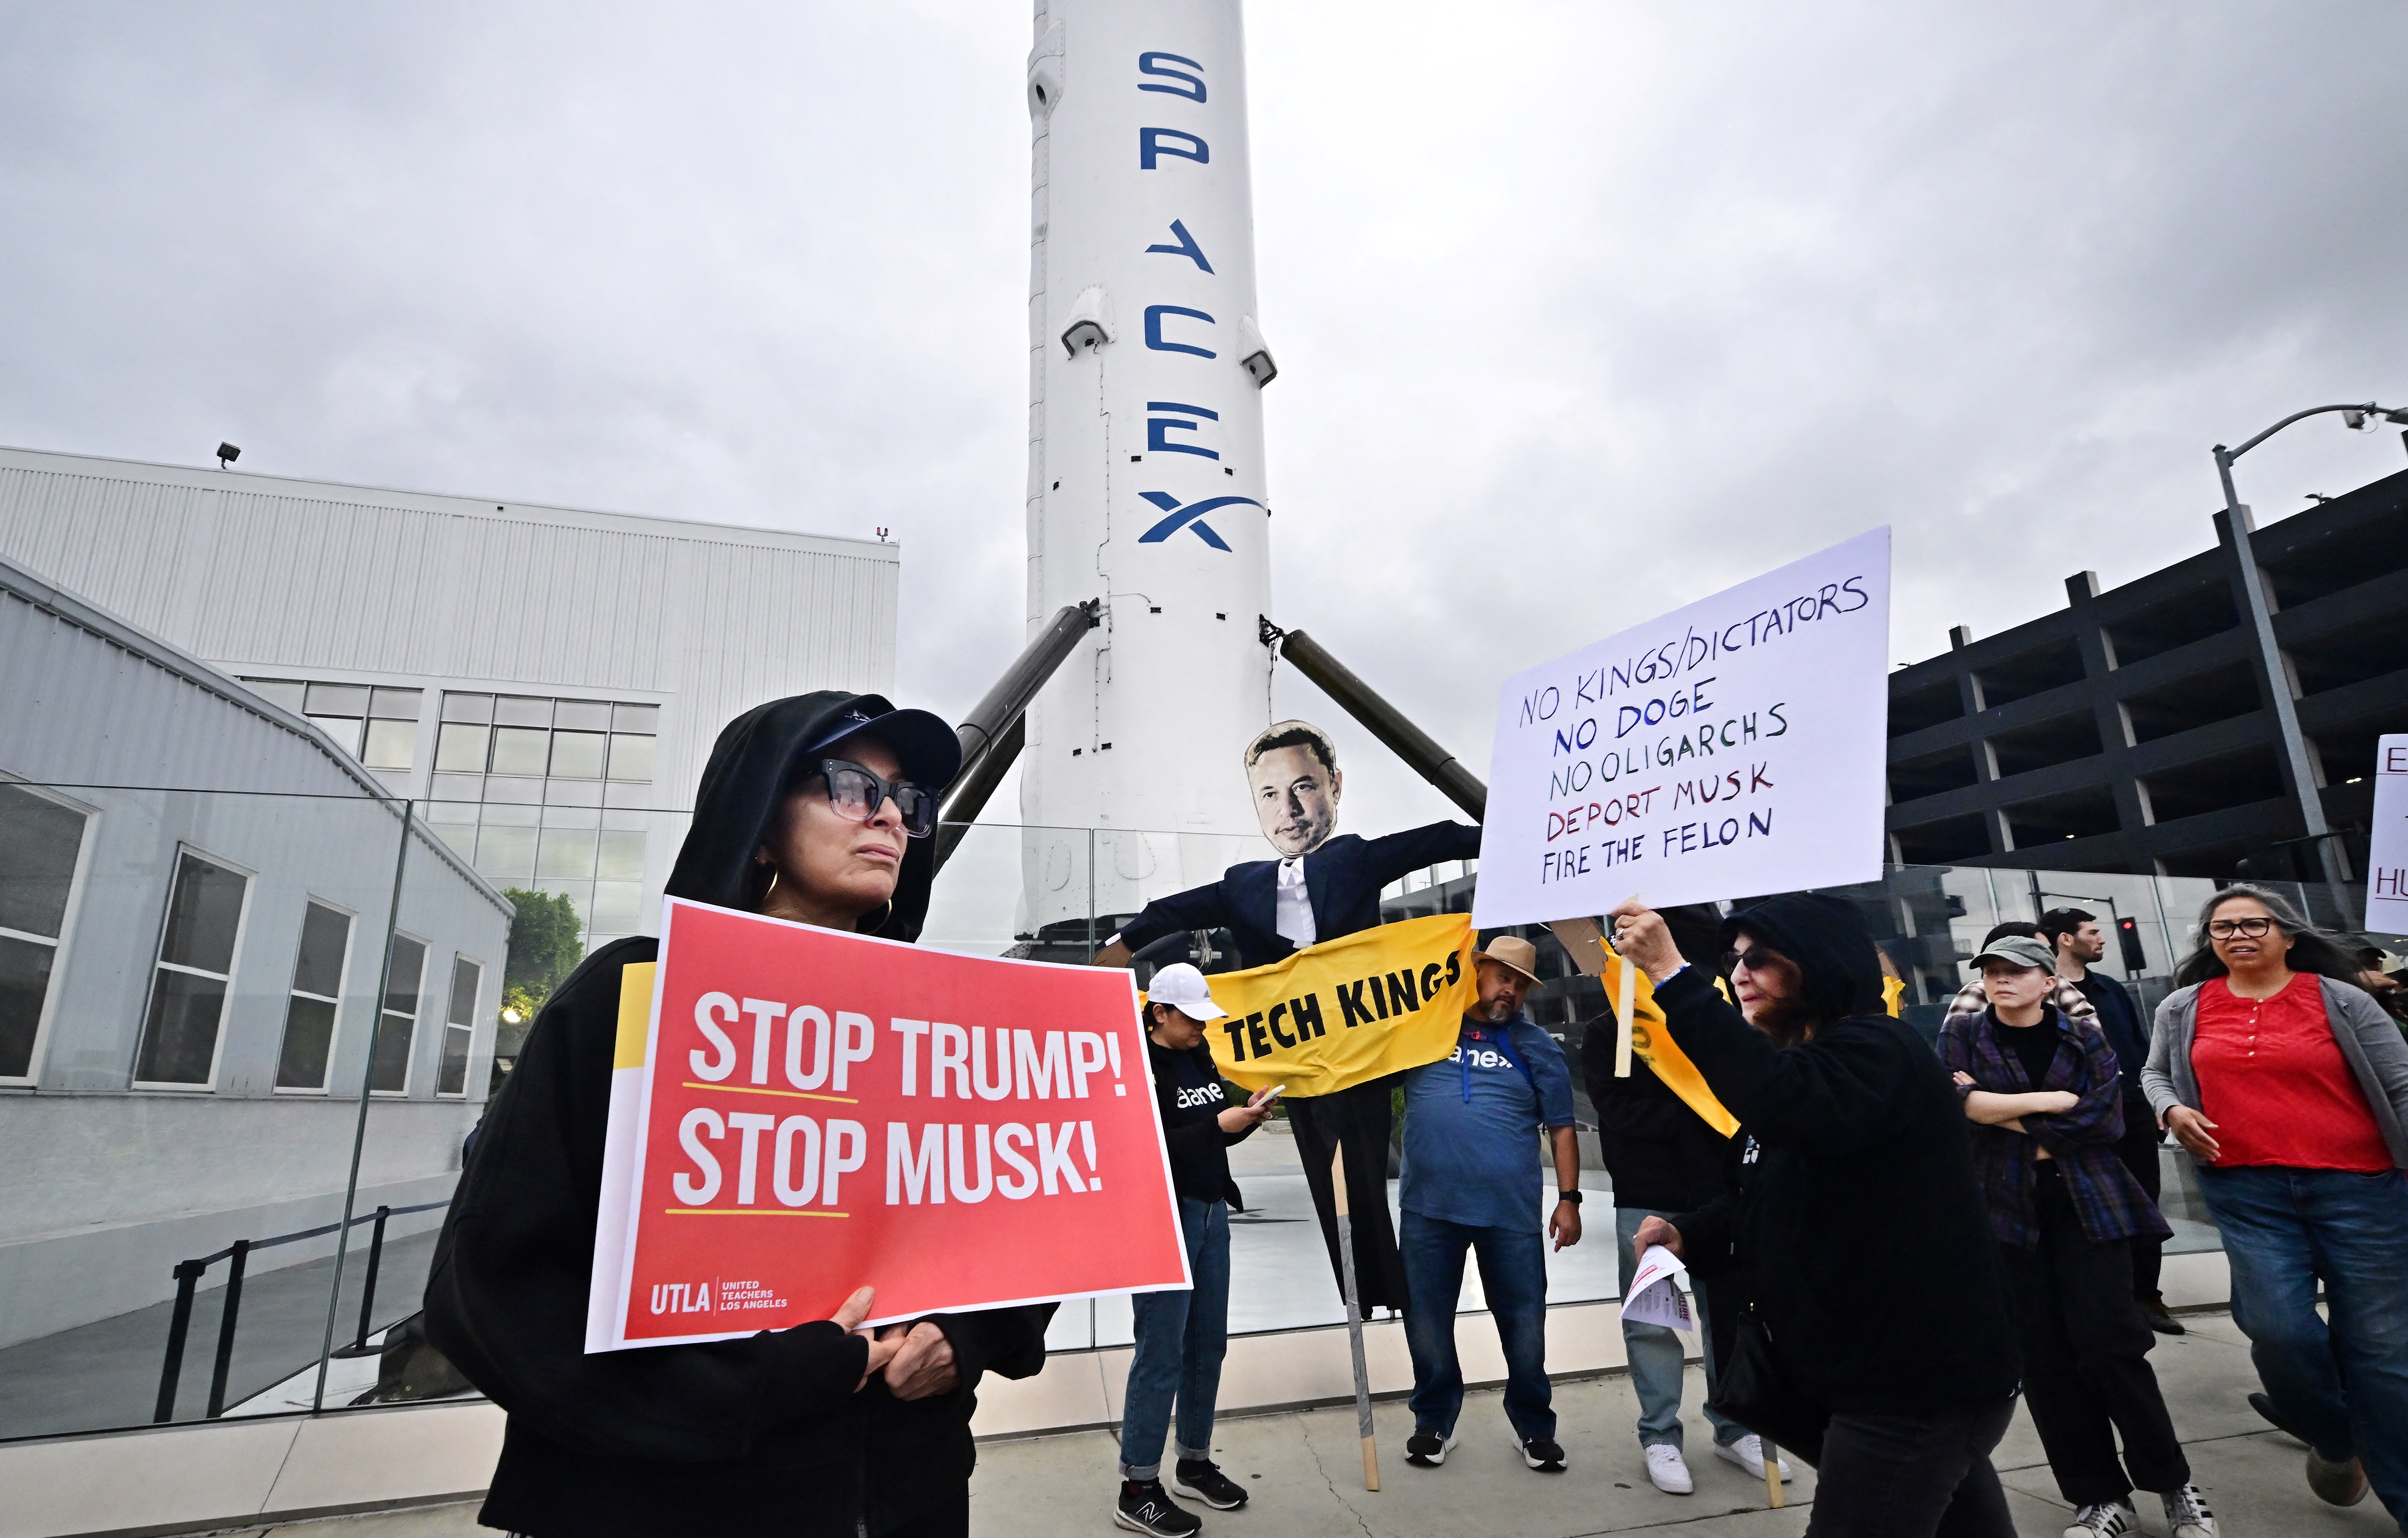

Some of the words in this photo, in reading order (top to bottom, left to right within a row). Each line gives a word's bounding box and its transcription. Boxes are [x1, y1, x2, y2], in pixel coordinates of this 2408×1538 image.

[1520, 686, 1560, 729] NO
[1576, 576, 1869, 710] KINGS/DICTATORS
[1550, 761, 1592, 802] NO
[1601, 703, 1787, 783] OLIGARCHS
[1554, 718, 1597, 757] NO
[1615, 676, 1717, 739] DOGE
[1548, 785, 1662, 843] DEPORT
[1674, 761, 1774, 811] MUSK
[1543, 845, 1591, 885] FIRE
[1602, 834, 1645, 868] THE
[1663, 807, 1772, 858] FELON
[689, 991, 874, 1091] STOP
[891, 1017, 1127, 1099] TRUMP!
[1224, 993, 1326, 1062] TECH
[1336, 950, 1461, 1028] KINGS
[673, 1107, 867, 1207] STOP
[886, 1121, 1103, 1205] MUSK!
[651, 1283, 710, 1315] UTLA
[720, 1301, 740, 1311] LOS
[742, 1299, 787, 1309] ANGELES
[722, 1281, 760, 1290] UNITED
[722, 1290, 773, 1300] TEACHERS
